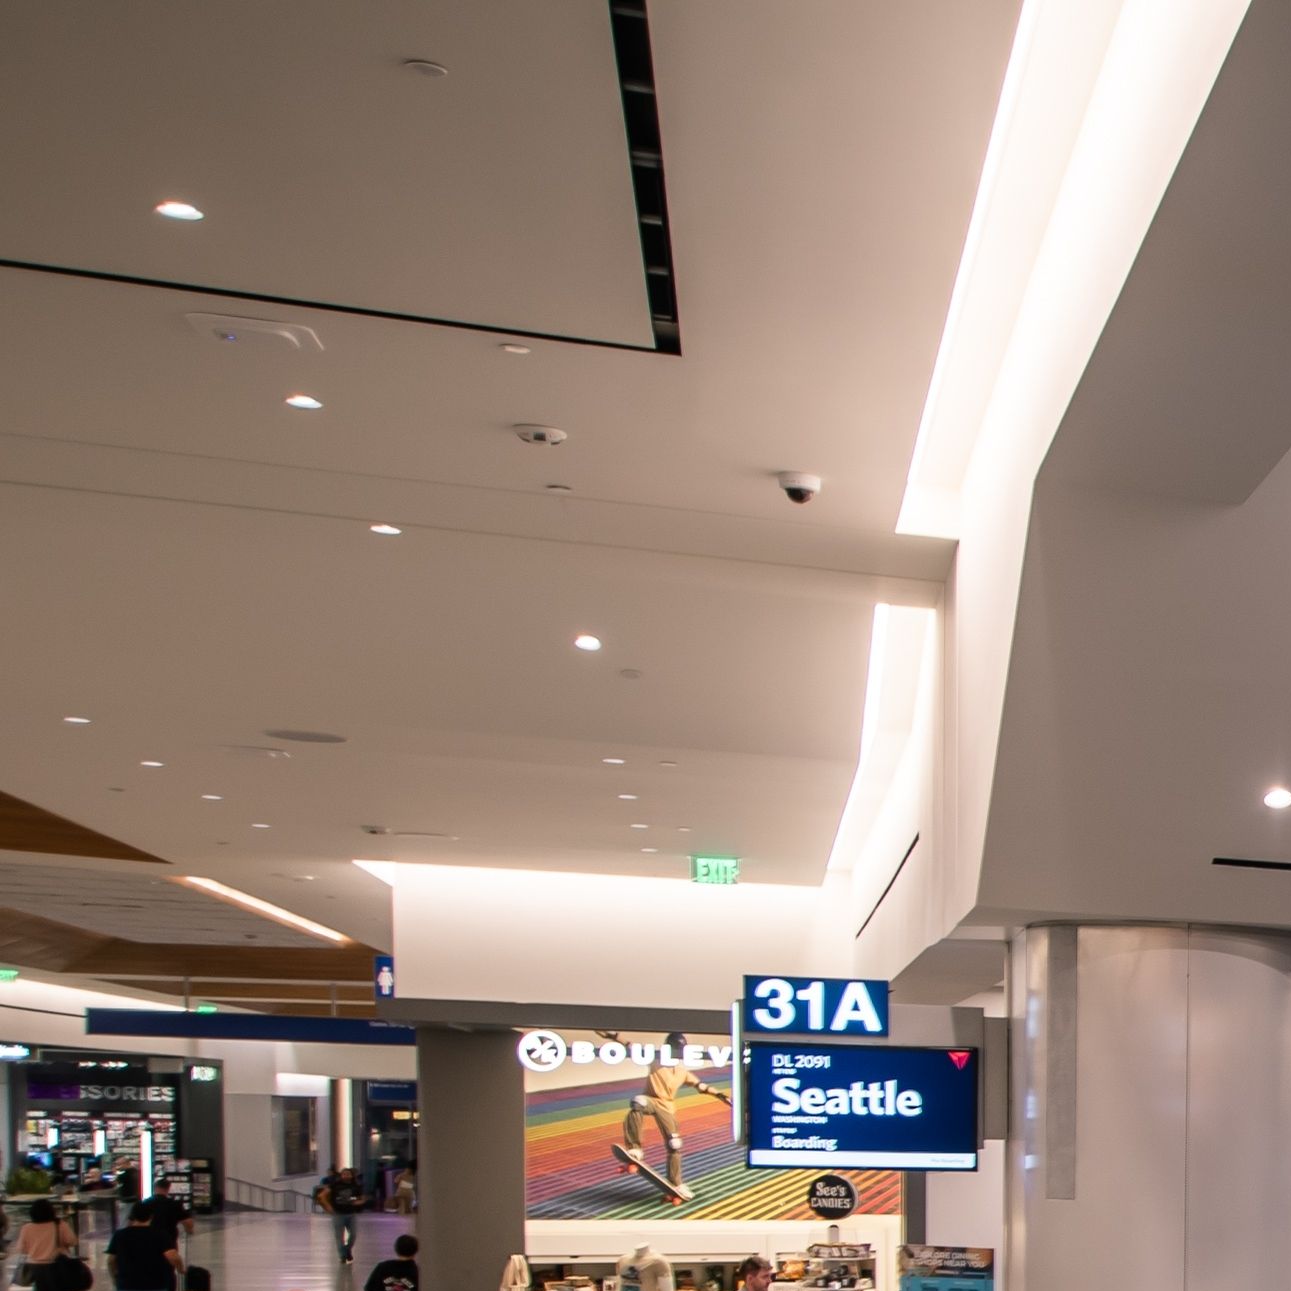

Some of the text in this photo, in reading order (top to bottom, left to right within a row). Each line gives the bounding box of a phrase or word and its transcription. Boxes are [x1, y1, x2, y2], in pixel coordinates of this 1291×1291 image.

[696, 858, 739, 884] EXIT
[753, 978, 882, 1032] 31A
[571, 1041, 752, 1068] BOULEV
[772, 1053, 831, 1069] DL 2091
[772, 1077, 923, 1117] Seattle
[772, 1135, 839, 1152] Boarding
[816, 1181, 847, 1197] See's
